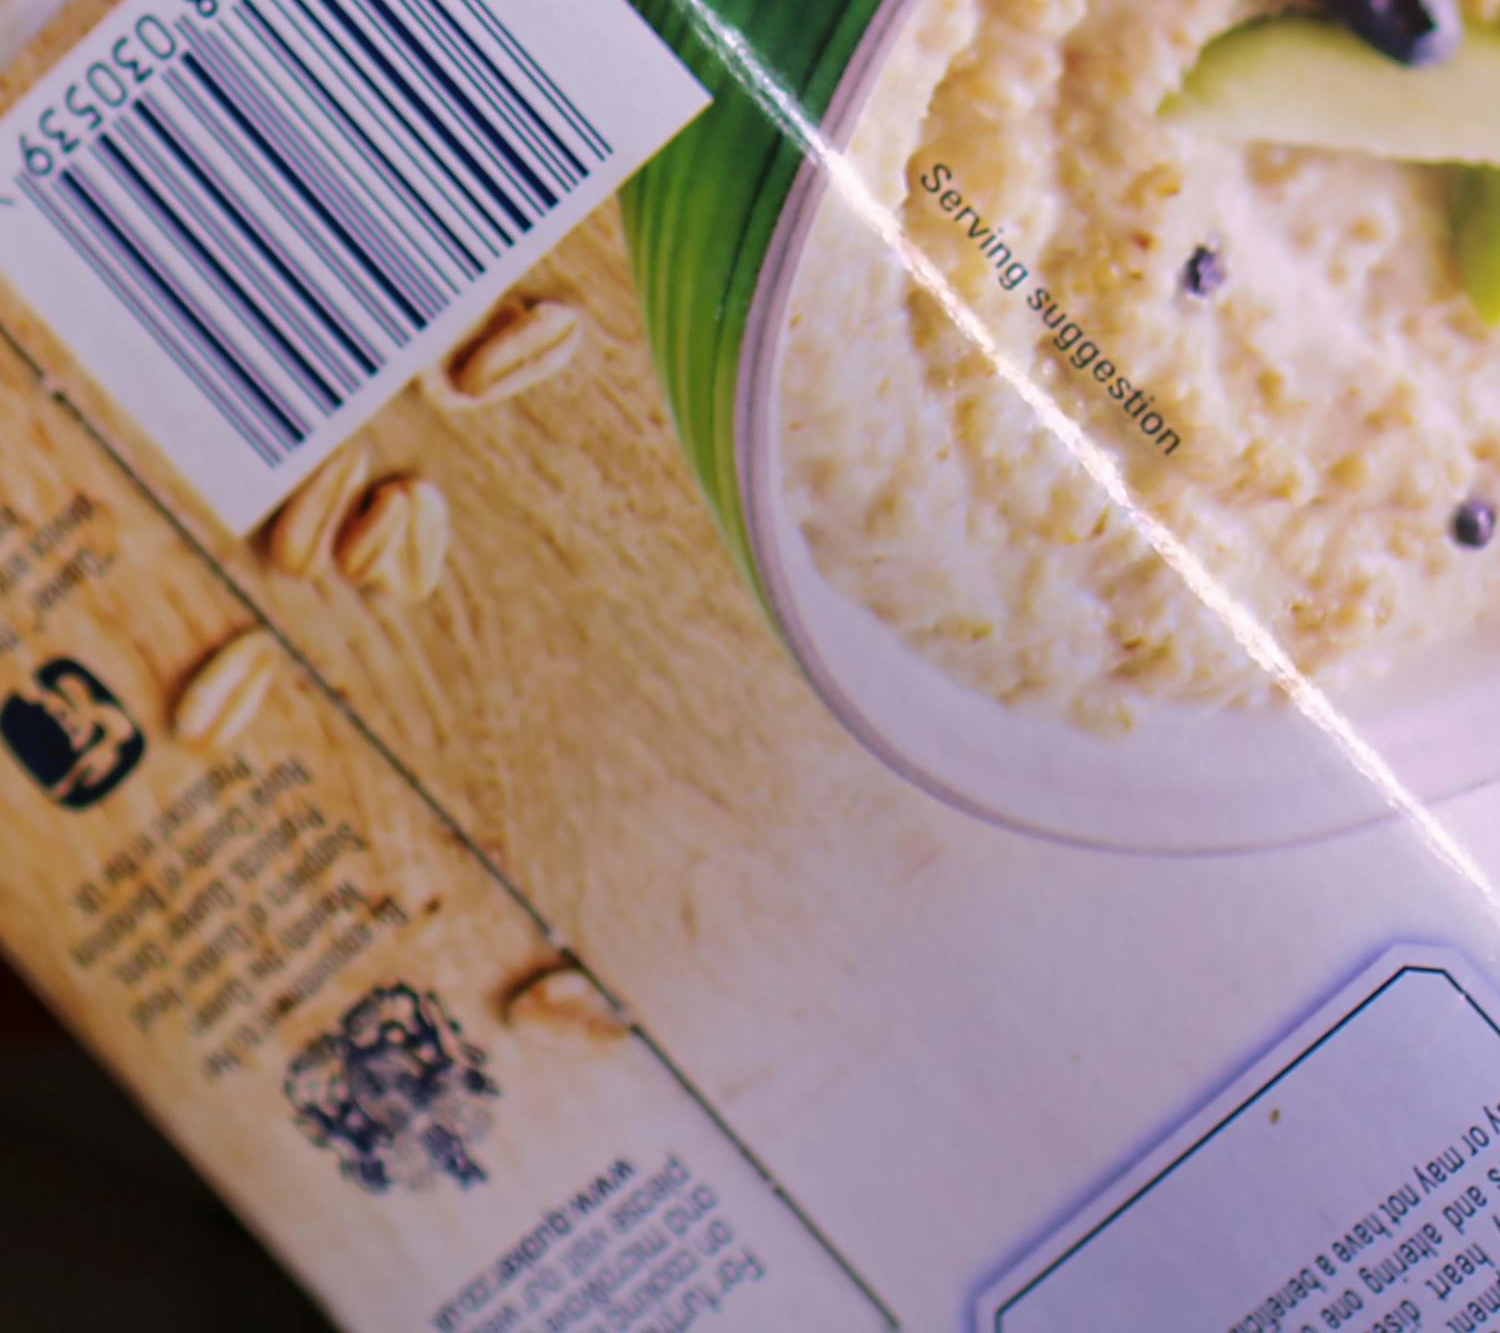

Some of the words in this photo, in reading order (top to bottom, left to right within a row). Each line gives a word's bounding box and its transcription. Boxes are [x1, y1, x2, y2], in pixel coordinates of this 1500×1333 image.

[19, 13, 177, 179] 030539
[920, 162, 1029, 290] Serving
[1027, 288, 1182, 456] suggestion
[1460, 1123, 1491, 1158] or
[1412, 1145, 1466, 1195] may
[662, 1183, 719, 1238] and
[1377, 1182, 1422, 1226] not
[1441, 1183, 1489, 1235] and
[1313, 1252, 1337, 1278] a
[1330, 1211, 1390, 1265] have
[1358, 1221, 1445, 1297] altering
[1424, 1241, 1493, 1303] heart
[1228, 1266, 1323, 1333] benefic
[1319, 1287, 1365, 1330] one
